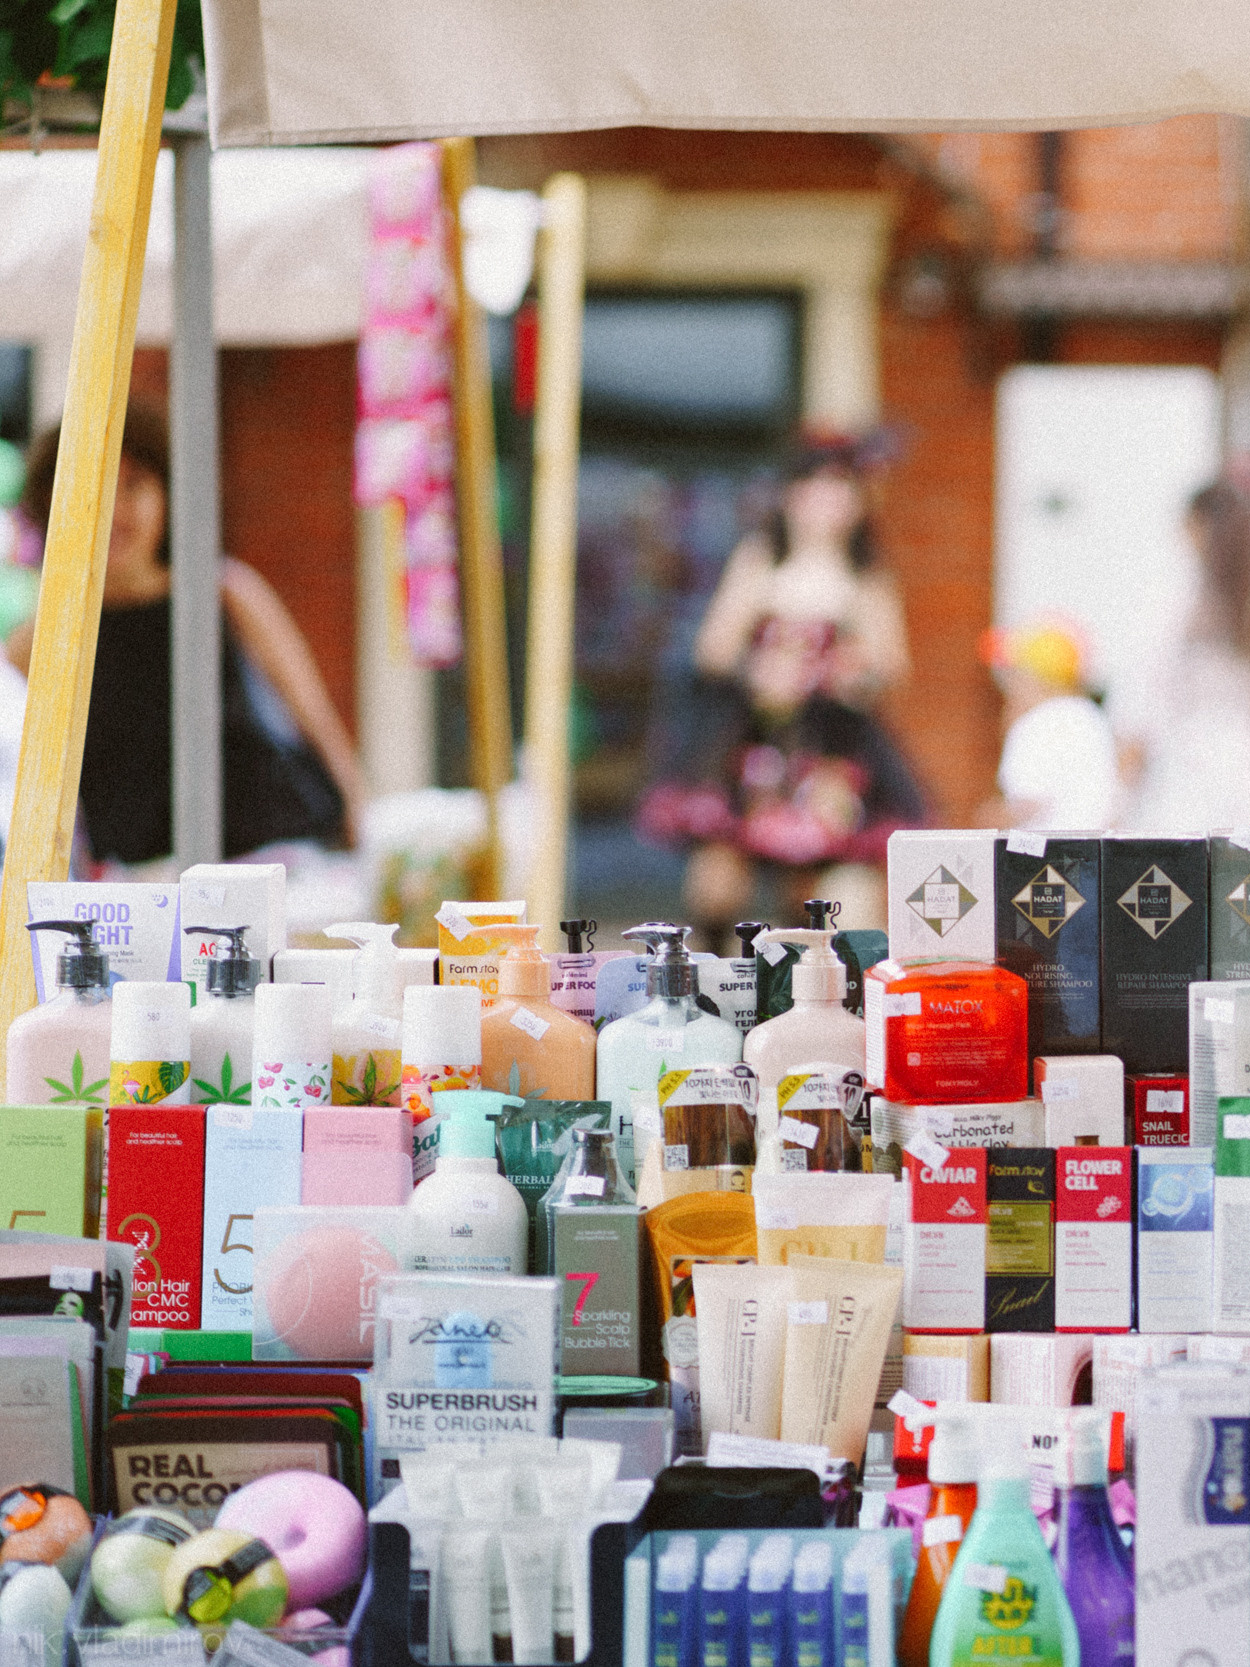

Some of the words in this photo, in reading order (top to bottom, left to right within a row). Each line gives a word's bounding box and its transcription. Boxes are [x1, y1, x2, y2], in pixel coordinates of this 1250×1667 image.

[1033, 895, 1064, 904] HADAT
[1139, 895, 1170, 904] HADAT
[74, 902, 131, 923] GOOD
[450, 963, 477, 974] Farm
[1032, 963, 1065, 972] HYDRO
[1115, 973, 1146, 981] HYDRO
[719, 982, 754, 992] SUPER
[1027, 980, 1049, 988] TURE
[1049, 980, 1093, 989] SHAMPOO
[1142, 1121, 1174, 1131] SNAIL
[1142, 1133, 1189, 1145] TRUECIC
[1064, 1159, 1123, 1175] FLOWER
[919, 1166, 978, 1184] CAVIAR
[1064, 1175, 1099, 1191] CELL
[159, 1279, 190, 1292] Hair
[147, 1293, 190, 1308] CMC
[211, 1295, 248, 1306] Perfect
[565, 1272, 600, 1327] 7
[129, 1309, 190, 1323] ampoo
[574, 1309, 631, 1324] Sparkling
[594, 1322, 631, 1337] Scalp
[564, 1336, 605, 1349] Bubble
[386, 1392, 538, 1412] SUPERBRUSH
[387, 1415, 427, 1432] THE
[433, 1415, 536, 1433] ORIGINAL
[127, 1453, 213, 1479] REAL
